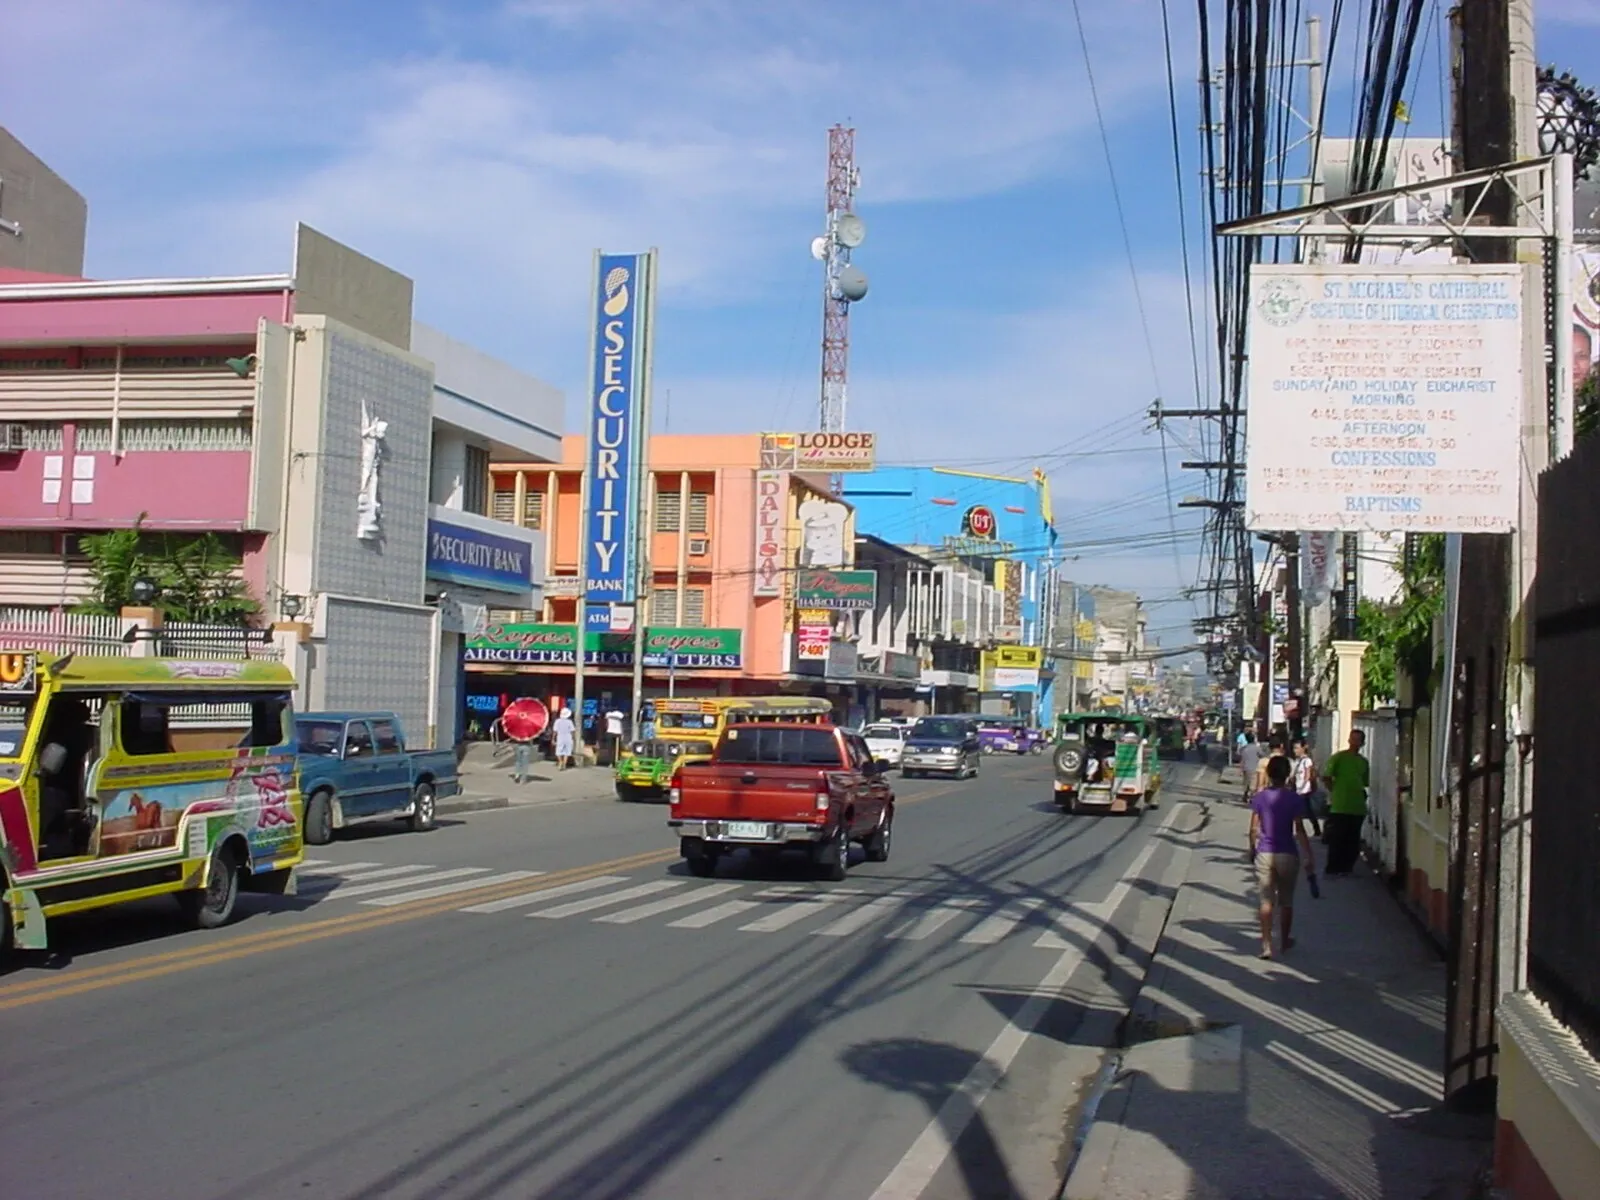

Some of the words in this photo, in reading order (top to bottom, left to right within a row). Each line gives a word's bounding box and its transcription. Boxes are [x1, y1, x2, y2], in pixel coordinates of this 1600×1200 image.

[1429, 282, 1508, 299] CATHEDRAL
[1273, 380, 1324, 391] SUNDAY
[1331, 380, 1357, 391] AND
[1364, 381, 1418, 392] HOLIDAY
[1427, 381, 1496, 392] EUCHARIST
[1352, 393, 1415, 405] MORNING
[1342, 422, 1426, 434] AFTERNOON
[595, 320, 625, 573] SECURITY
[800, 433, 873, 448] LODGE
[1331, 451, 1436, 466] CONFESSIONS
[1345, 496, 1422, 512] BAPTISMS
[758, 481, 781, 587] DALISAY
[440, 535, 492, 568] SECURITY
[494, 547, 523, 574] BANK
[587, 579, 623, 591] BANK
[588, 615, 609, 623] ATM
[472, 623, 575, 649] Reyes
